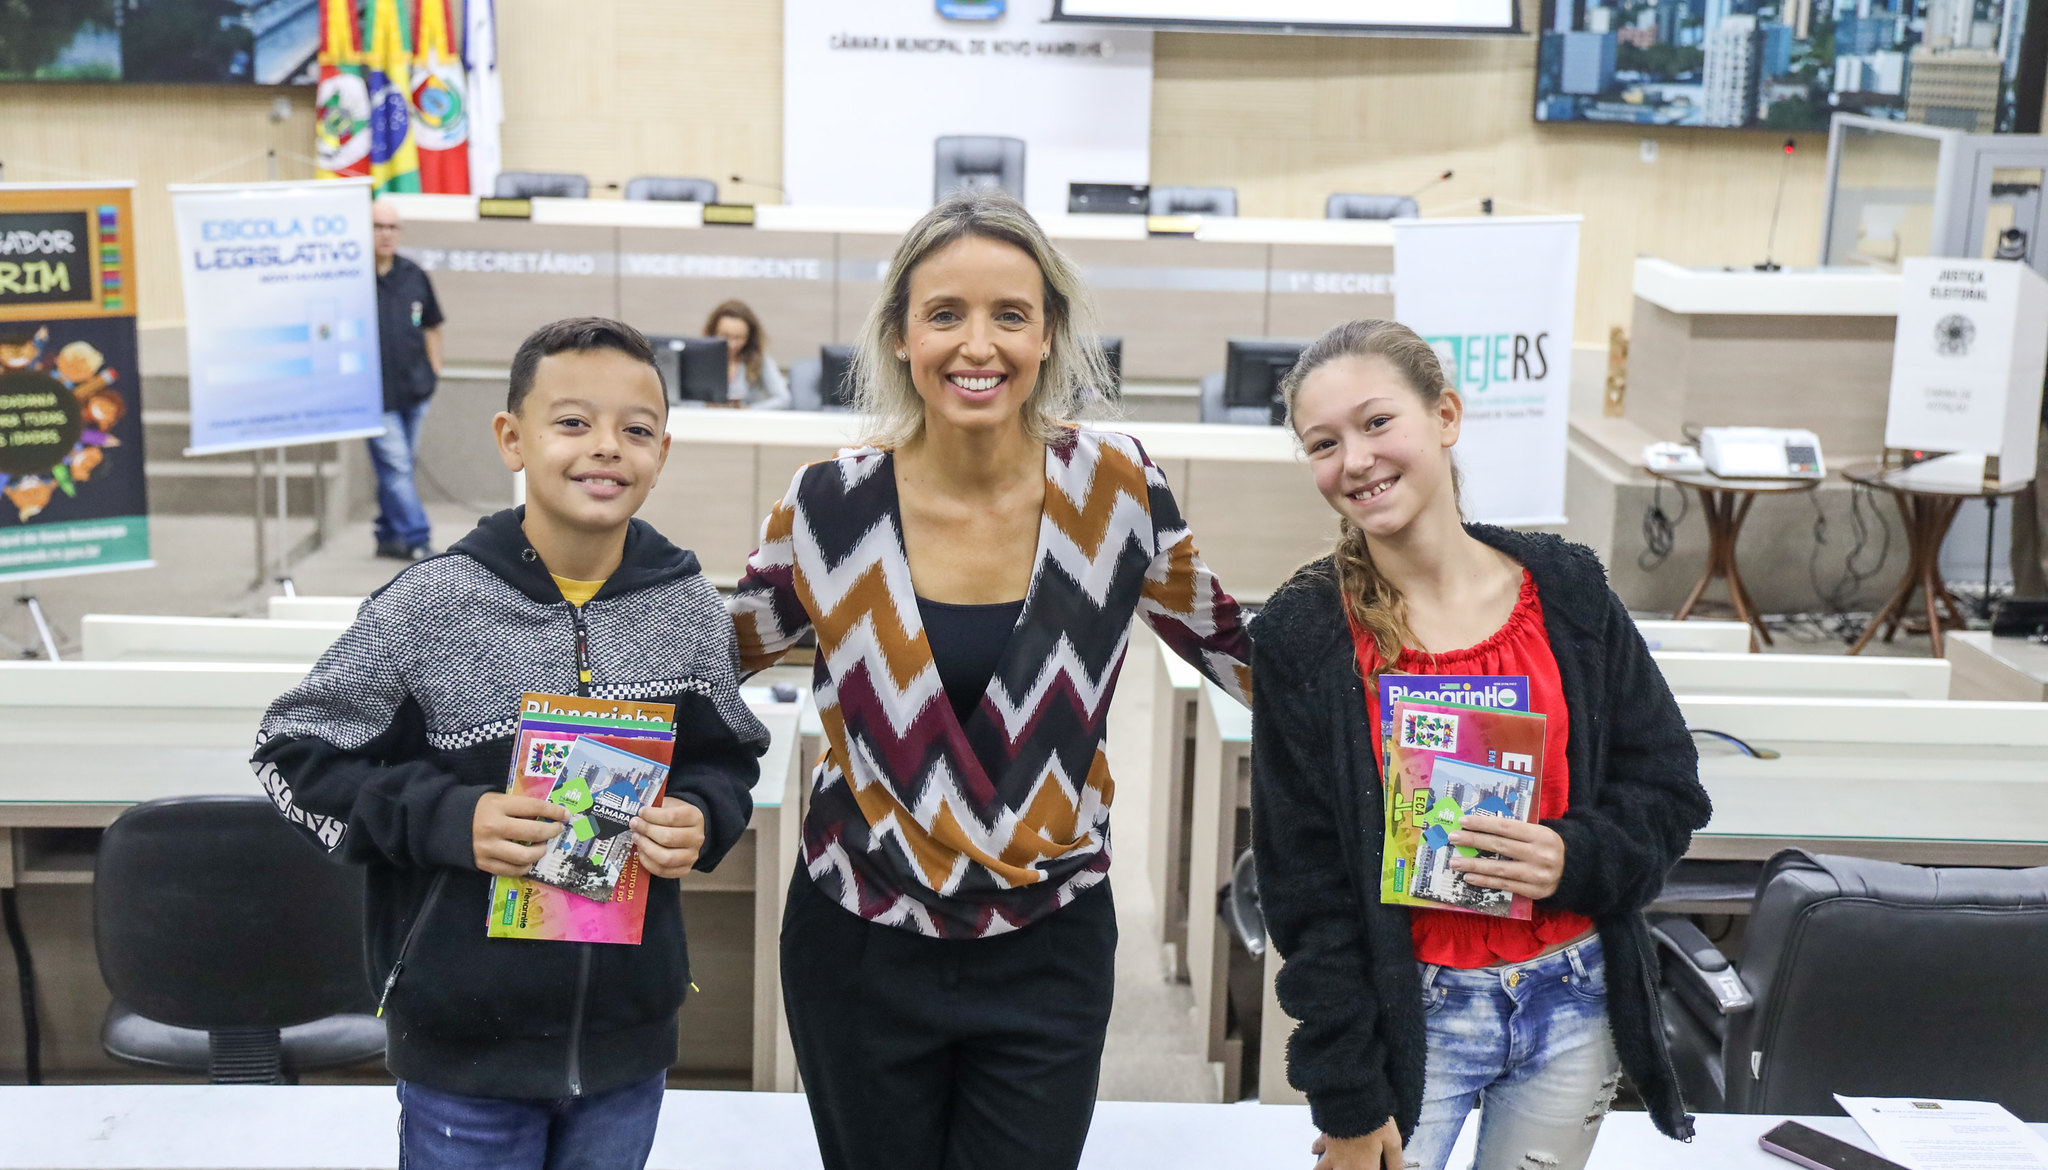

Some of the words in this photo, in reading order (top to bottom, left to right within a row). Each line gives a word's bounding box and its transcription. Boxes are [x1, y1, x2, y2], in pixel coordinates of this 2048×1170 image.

[896, 37, 963, 55] MUNICIPAL
[969, 39, 986, 55] DE
[992, 39, 1031, 56] NOVO
[202, 217, 305, 242] ESCOLA
[312, 214, 348, 236] DO
[0, 229, 76, 255] ADOR
[194, 241, 361, 271] LEGISLATIVO
[449, 249, 595, 276] SECRETÁRIO
[1929, 286, 1988, 302] ELEITORAL
[1465, 331, 1549, 393] EJERS
[592, 804, 631, 822] CÂMARA
[1415, 796, 1426, 816] ECA
[628, 851, 639, 889] ESTATUTO
[616, 891, 625, 902] DO
[626, 890, 635, 901] DA
